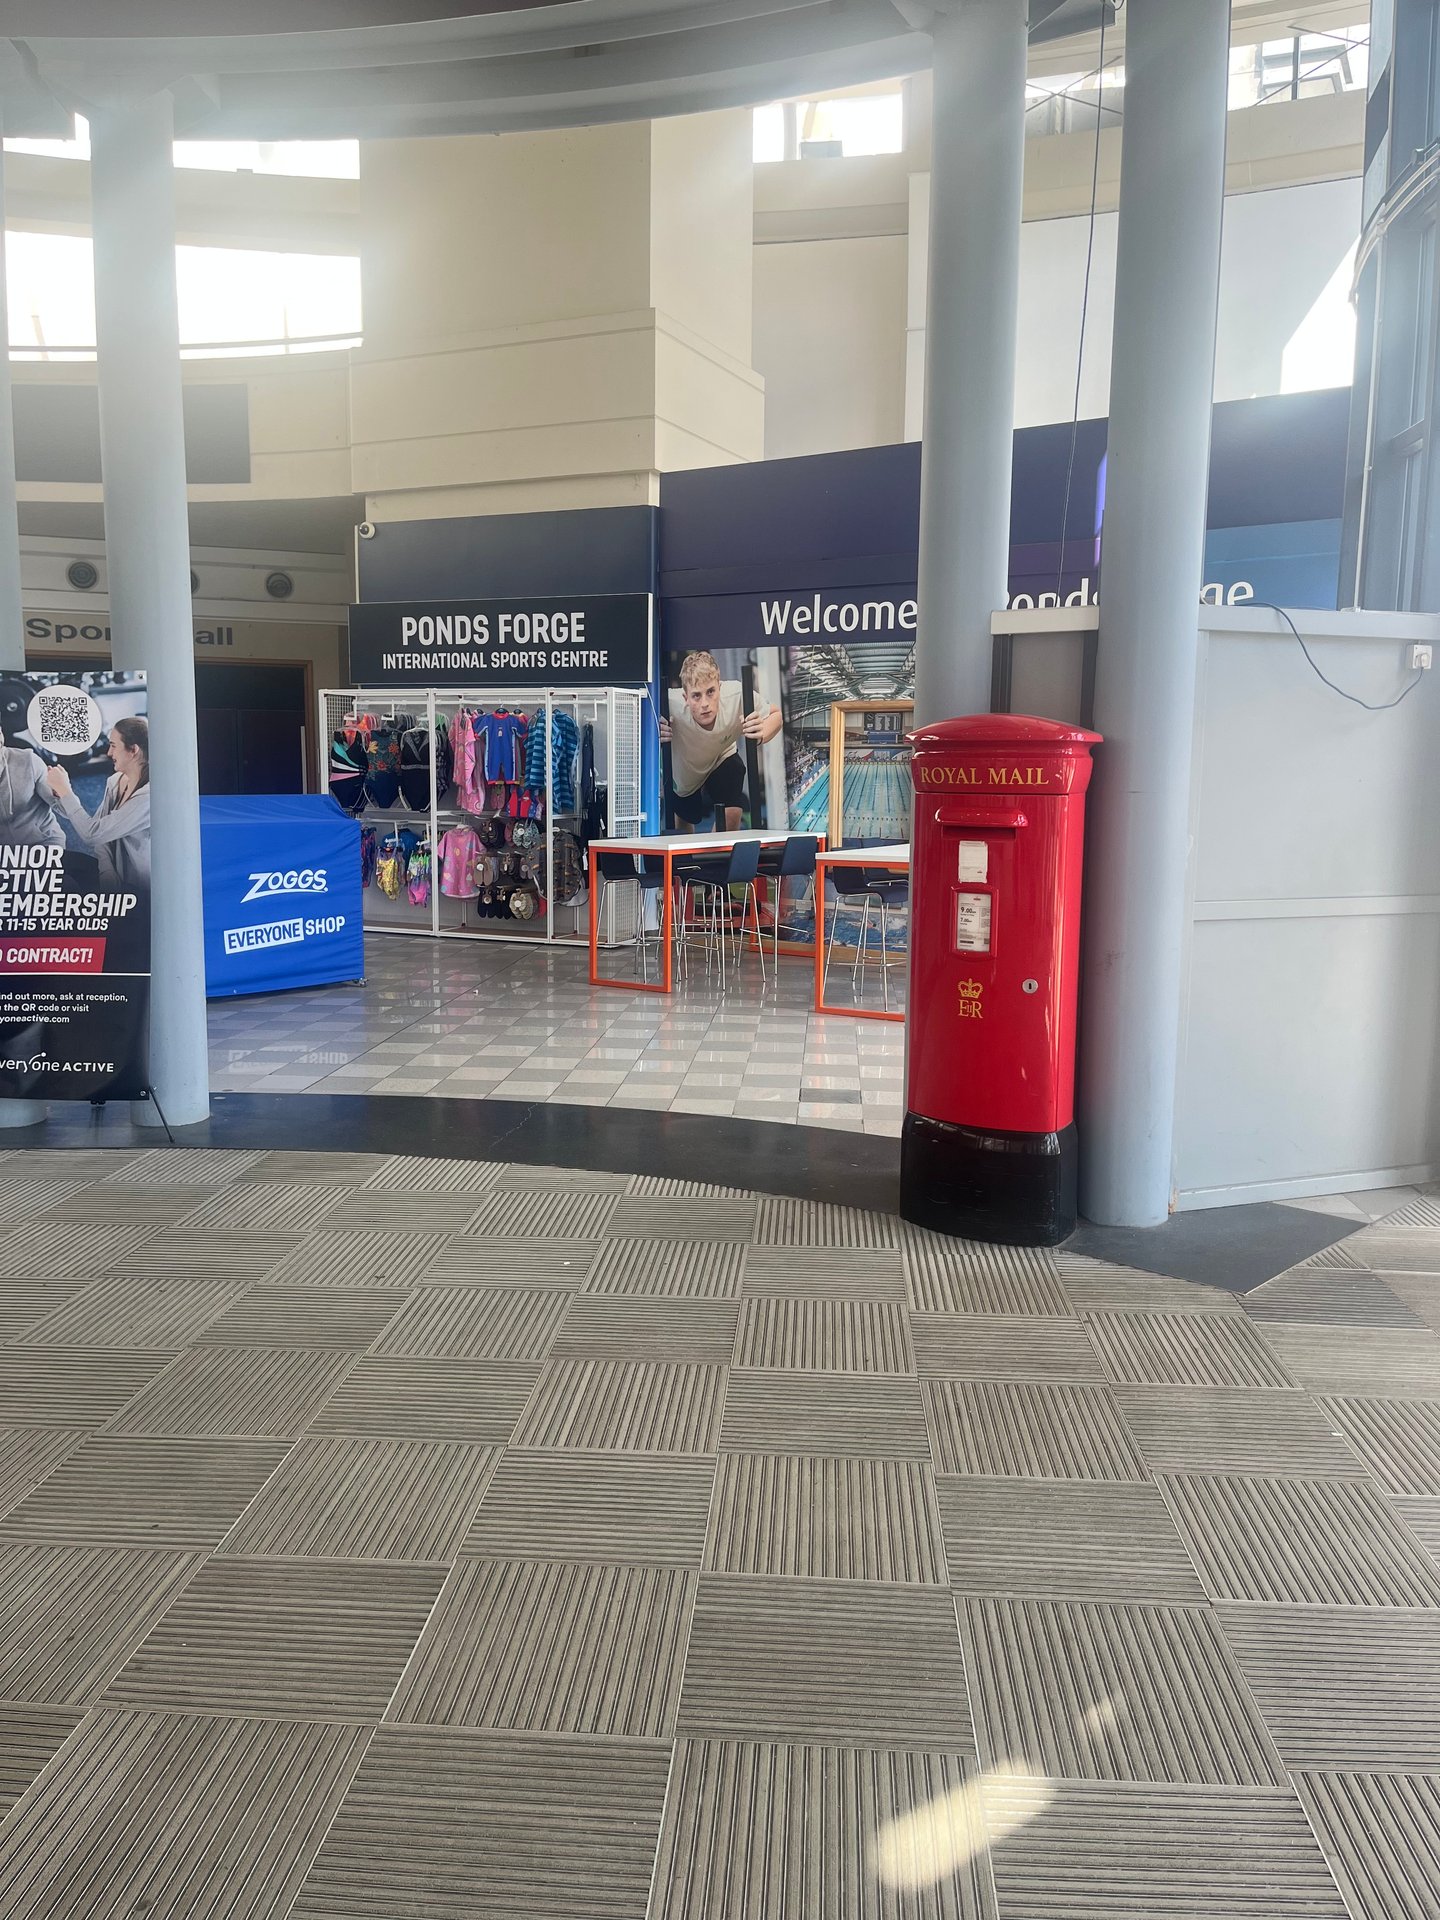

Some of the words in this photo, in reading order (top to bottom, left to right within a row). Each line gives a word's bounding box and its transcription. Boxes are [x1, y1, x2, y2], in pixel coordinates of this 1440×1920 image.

[760, 594, 918, 635] Welcome
[402, 615, 490, 646] PONDS
[498, 612, 585, 644] FORGE
[382, 652, 487, 670] INTERNATIONAL
[491, 651, 547, 668] SPORTS
[551, 650, 608, 668] CENTRE
[920, 767, 982, 785] ROYAL
[988, 767, 1049, 785] MAIL
[0, 844, 64, 868] NIOR
[240, 869, 328, 903] ZOGGS
[0, 893, 137, 917] EMBERSHIP
[6, 918, 37, 931] 11-15
[41, 918, 73, 931] YEAR
[77, 918, 109, 931] OLDS
[227, 921, 301, 950] EVERYONE
[305, 915, 346, 936] SHOP
[6, 948, 93, 963] CONTRACT!
[59, 992, 74, 1001] ask
[75, 993, 84, 1001] at
[86, 993, 128, 1002] reception,
[4, 1003, 19, 1012] the
[21, 1003, 36, 1012] QR
[38, 1004, 60, 1012] code
[71, 1004, 89, 1012] visit
[62, 1062, 114, 1073] ACTIVE
